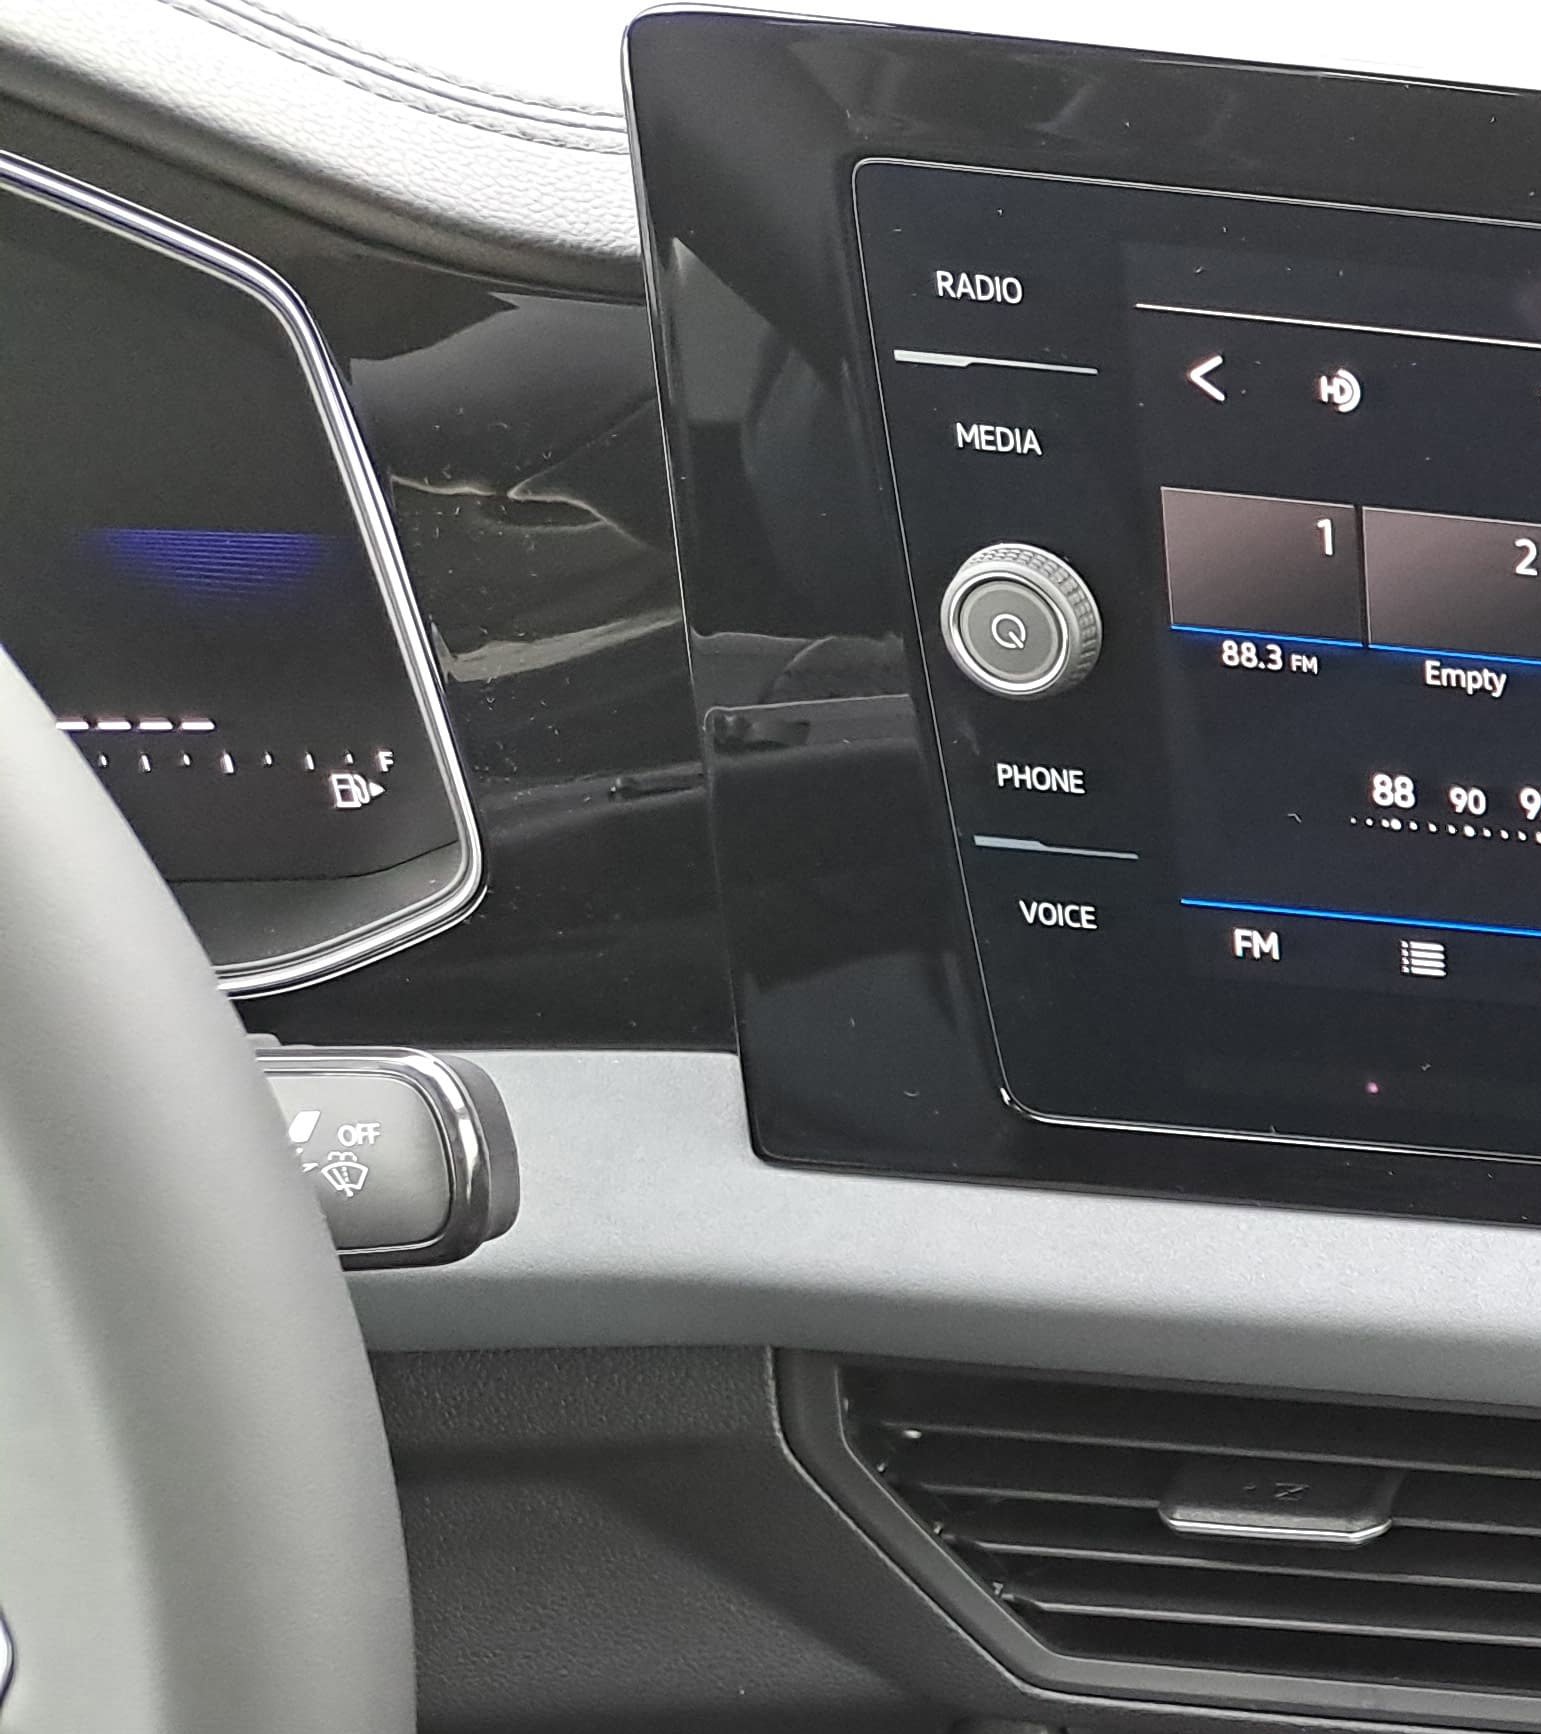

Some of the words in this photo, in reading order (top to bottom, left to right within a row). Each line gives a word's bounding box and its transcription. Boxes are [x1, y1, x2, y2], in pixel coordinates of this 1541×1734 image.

[936, 270, 1023, 304] RADIO
[956, 423, 1042, 456] MEDIA
[1316, 518, 1334, 556] 1
[1514, 538, 1539, 576] 2
[1222, 640, 1284, 672] 88.3
[1291, 654, 1319, 675] FM
[1424, 661, 1506, 699] Empty
[380, 750, 395, 773] F
[996, 763, 1087, 795] PHONE
[1371, 773, 1416, 809] 88
[1449, 786, 1487, 816] 90
[1019, 899, 1098, 930] VOICE
[1233, 928, 1280, 961] FM
[337, 1121, 380, 1148] OFF
